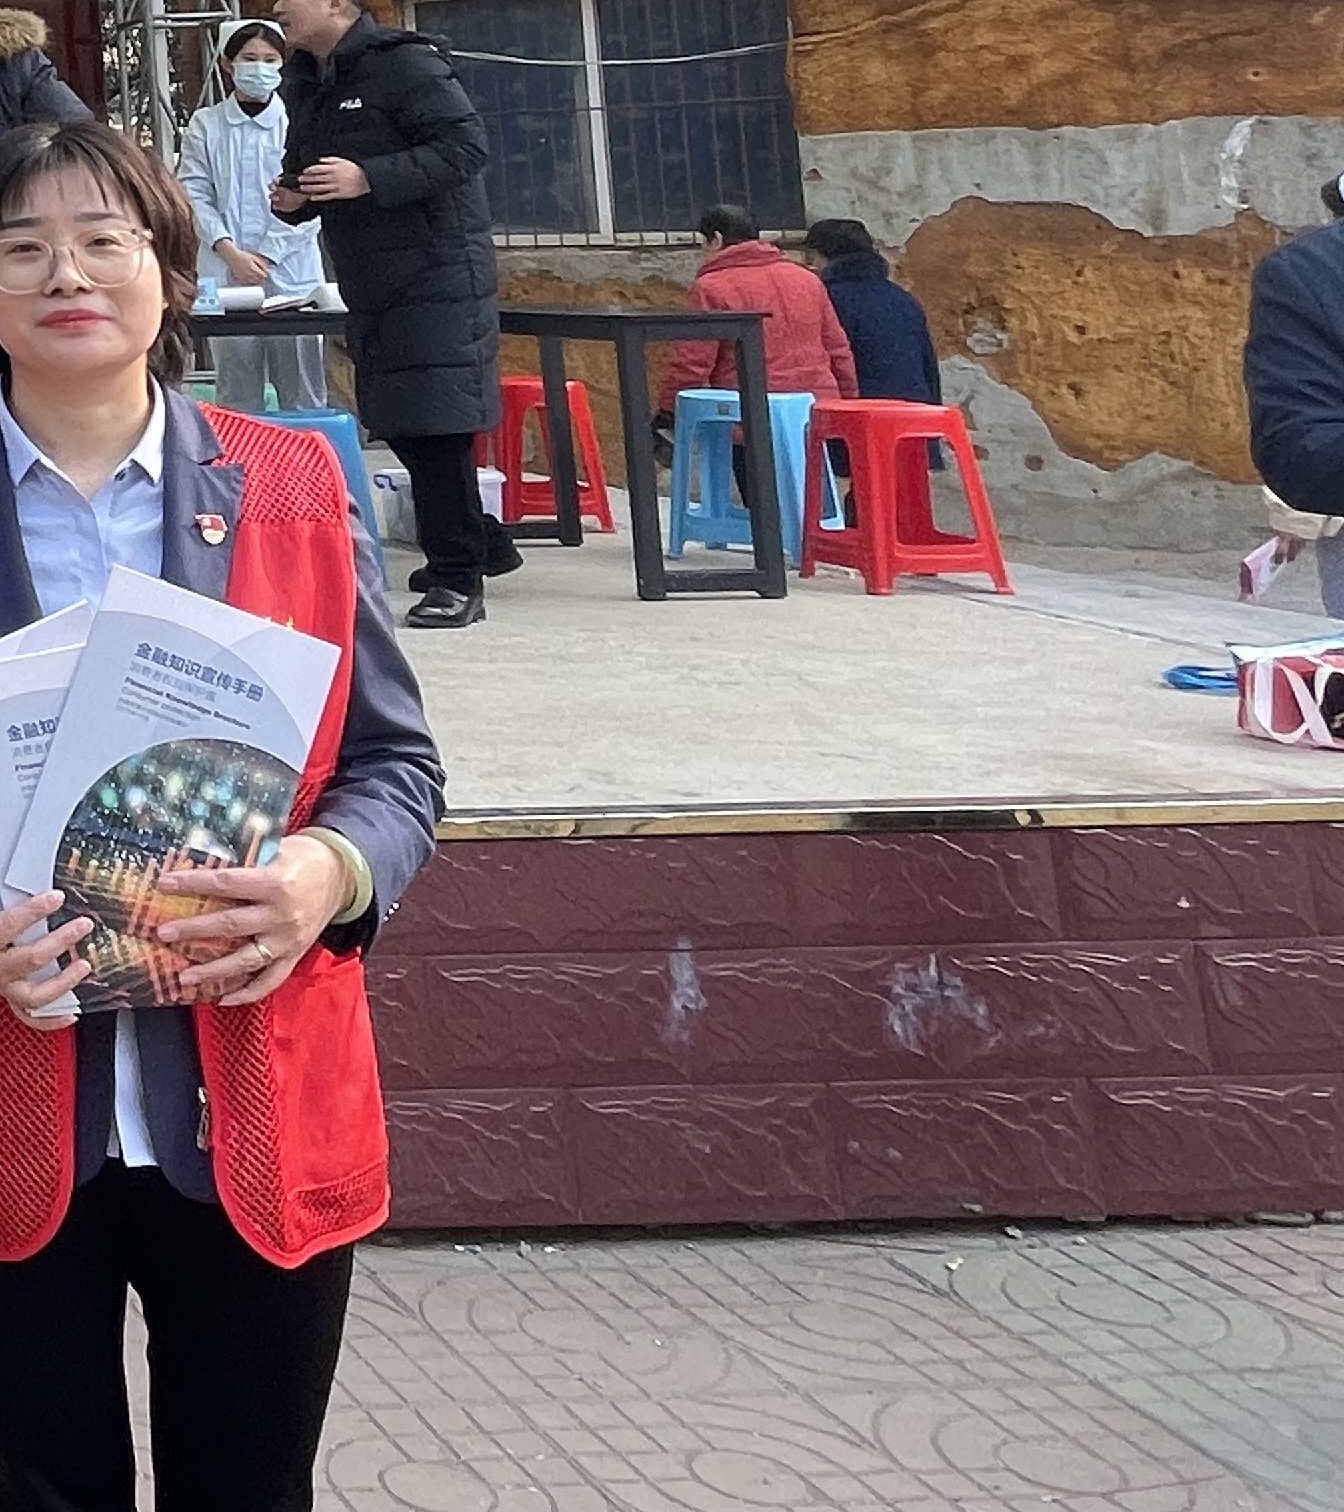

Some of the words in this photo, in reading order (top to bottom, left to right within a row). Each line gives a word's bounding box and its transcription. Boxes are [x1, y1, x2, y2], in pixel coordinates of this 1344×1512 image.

[134, 642, 263, 702] 金融知识宣传手册
[6, 716, 59, 742] 金融知
